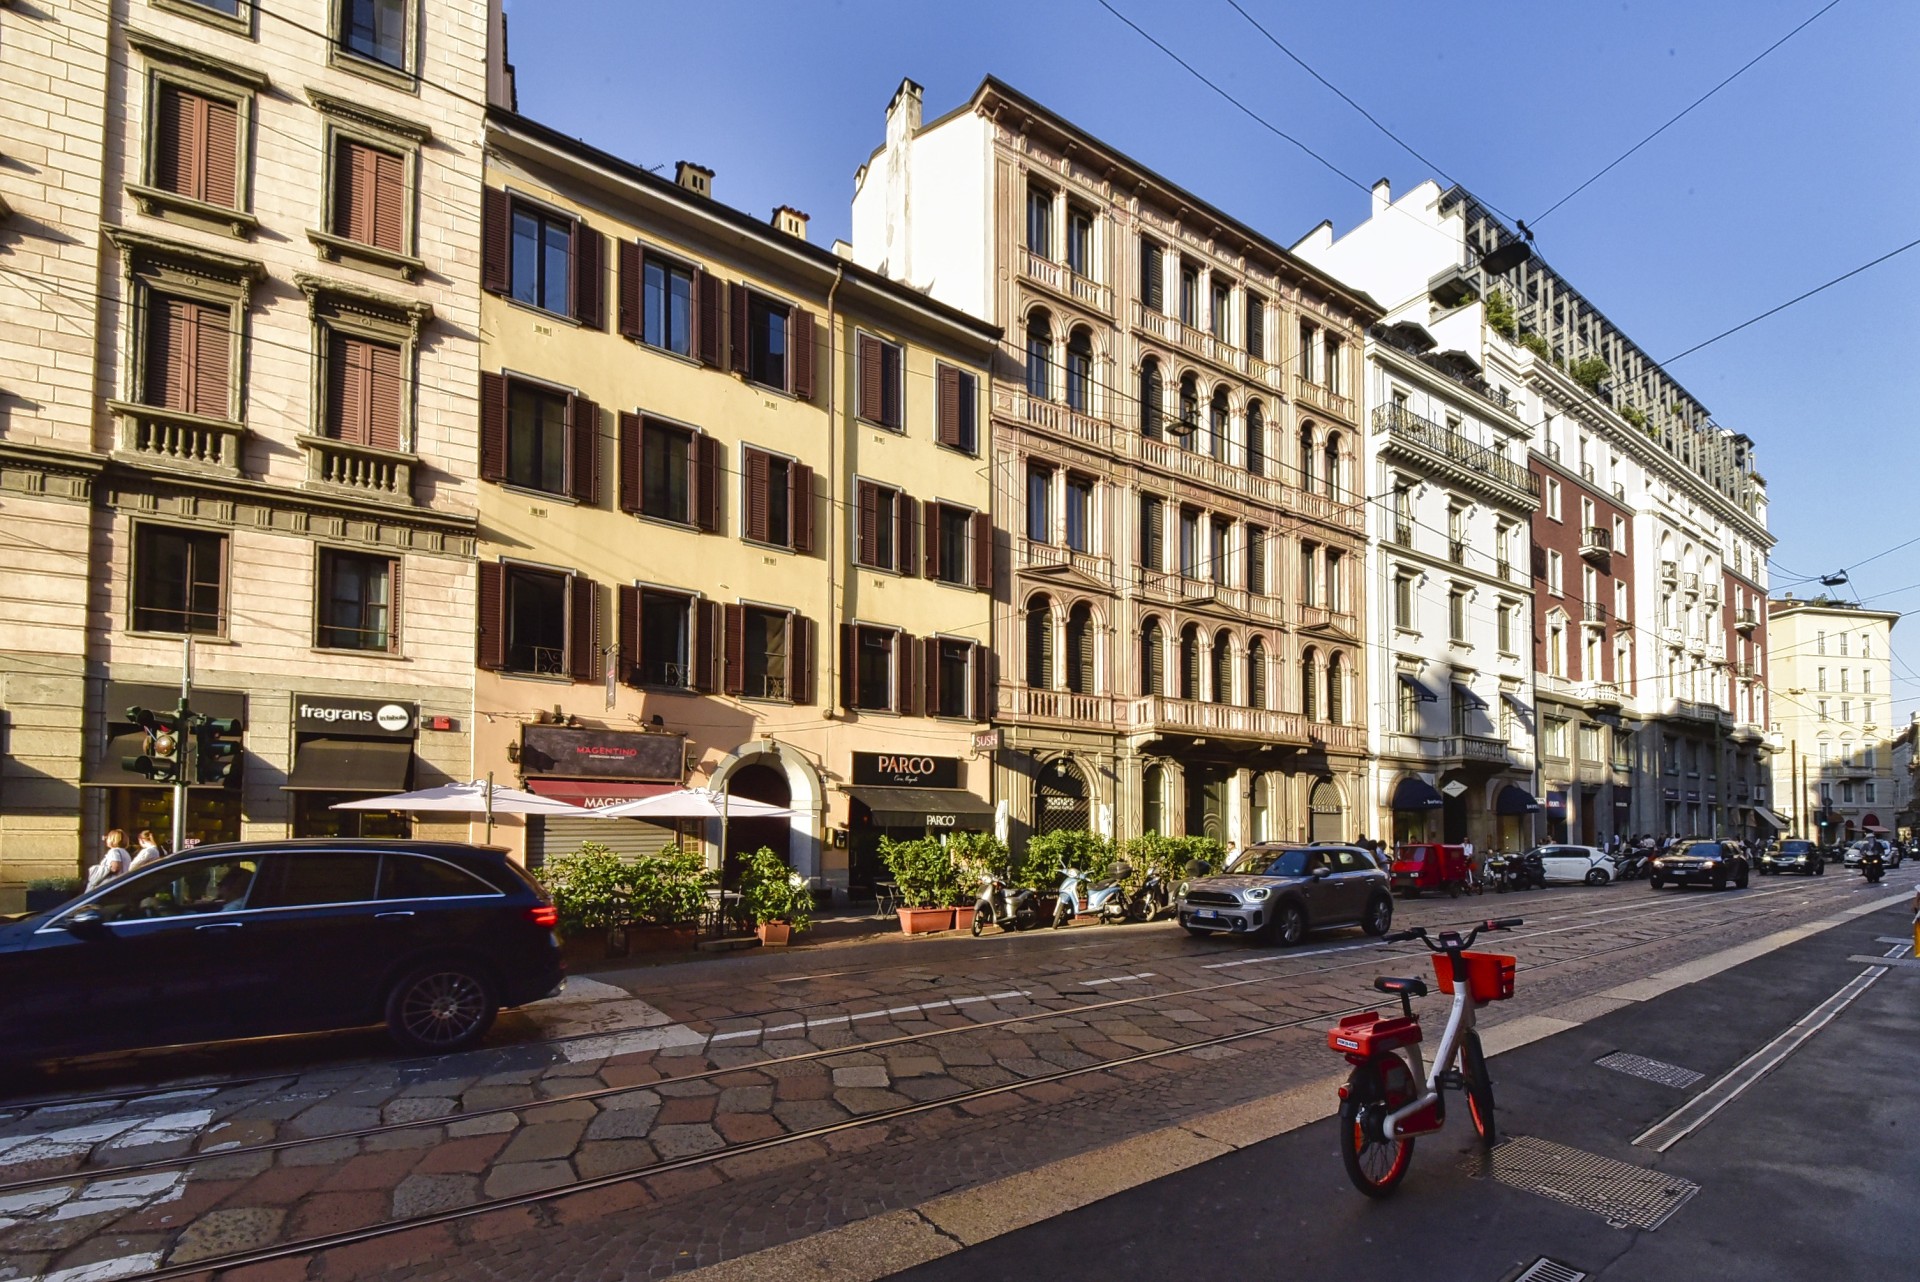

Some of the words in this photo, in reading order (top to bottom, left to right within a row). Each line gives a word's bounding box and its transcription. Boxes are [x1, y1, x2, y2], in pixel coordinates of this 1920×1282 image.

[300, 704, 373, 722] fragrans
[577, 746, 637, 756] MAGENTINO
[878, 756, 934, 774] PARCO
[584, 797, 639, 807] MAGE
